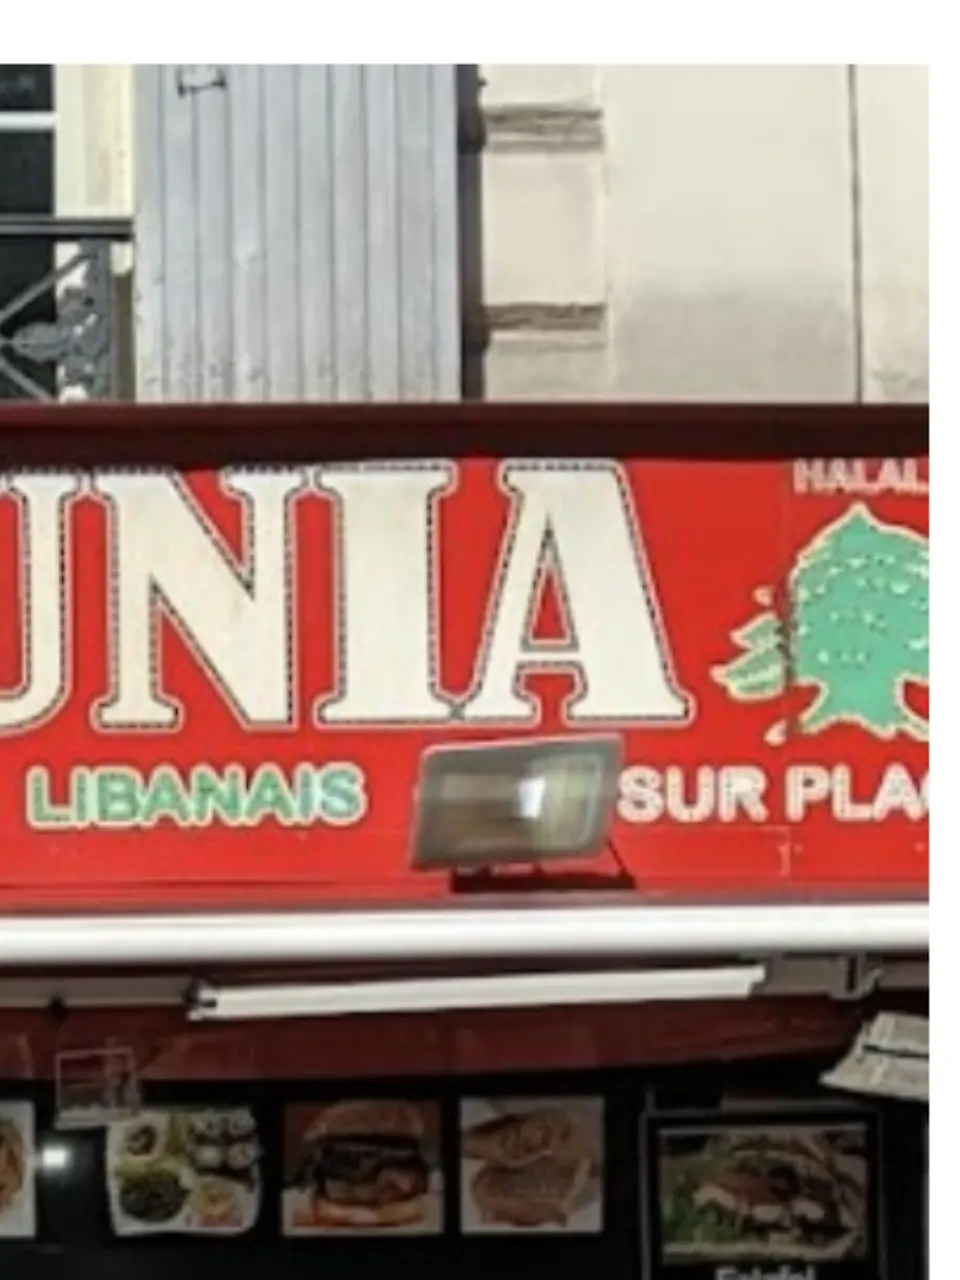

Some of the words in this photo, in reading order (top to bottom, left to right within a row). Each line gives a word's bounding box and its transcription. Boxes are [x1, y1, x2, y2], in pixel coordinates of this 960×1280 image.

[26, 763, 366, 827] LIBANAIS
[617, 763, 769, 823] SUR
[784, 763, 929, 822] PLA
